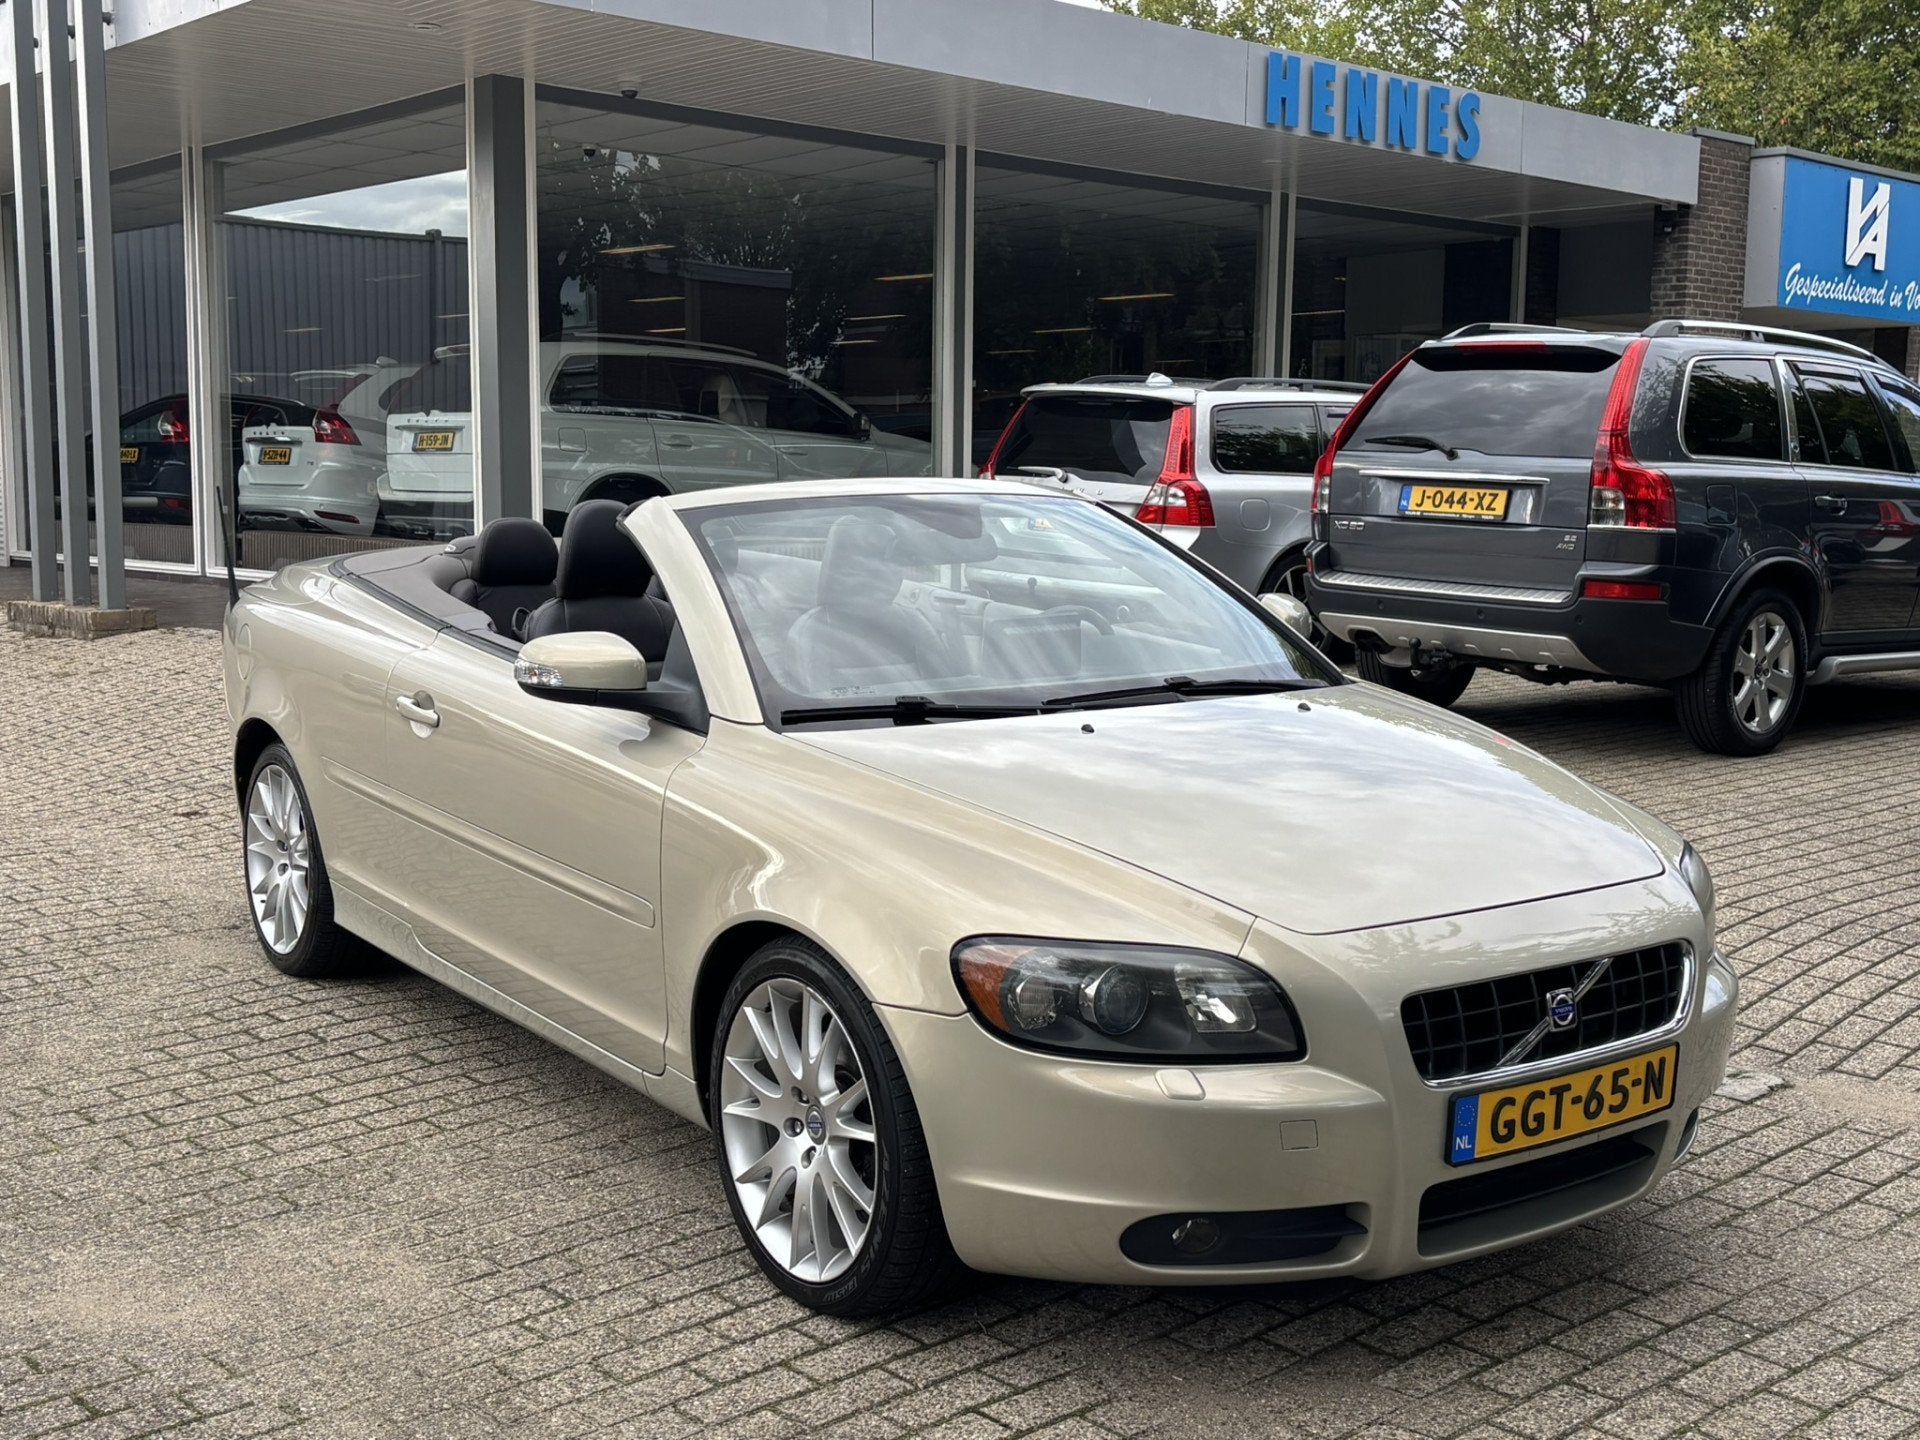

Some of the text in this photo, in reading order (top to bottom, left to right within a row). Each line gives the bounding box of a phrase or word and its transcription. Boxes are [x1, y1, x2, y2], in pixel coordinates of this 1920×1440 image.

[1266, 51, 1481, 160] HENNES
[1785, 262, 1888, 306] Gespecialiseerd
[1889, 281, 1904, 308] in
[418, 434, 450, 447] H-159-JN
[1415, 490, 1499, 511] J-044-XZ
[1491, 1057, 1665, 1144] GGT-65-N
[1455, 1136, 1472, 1151] NL
